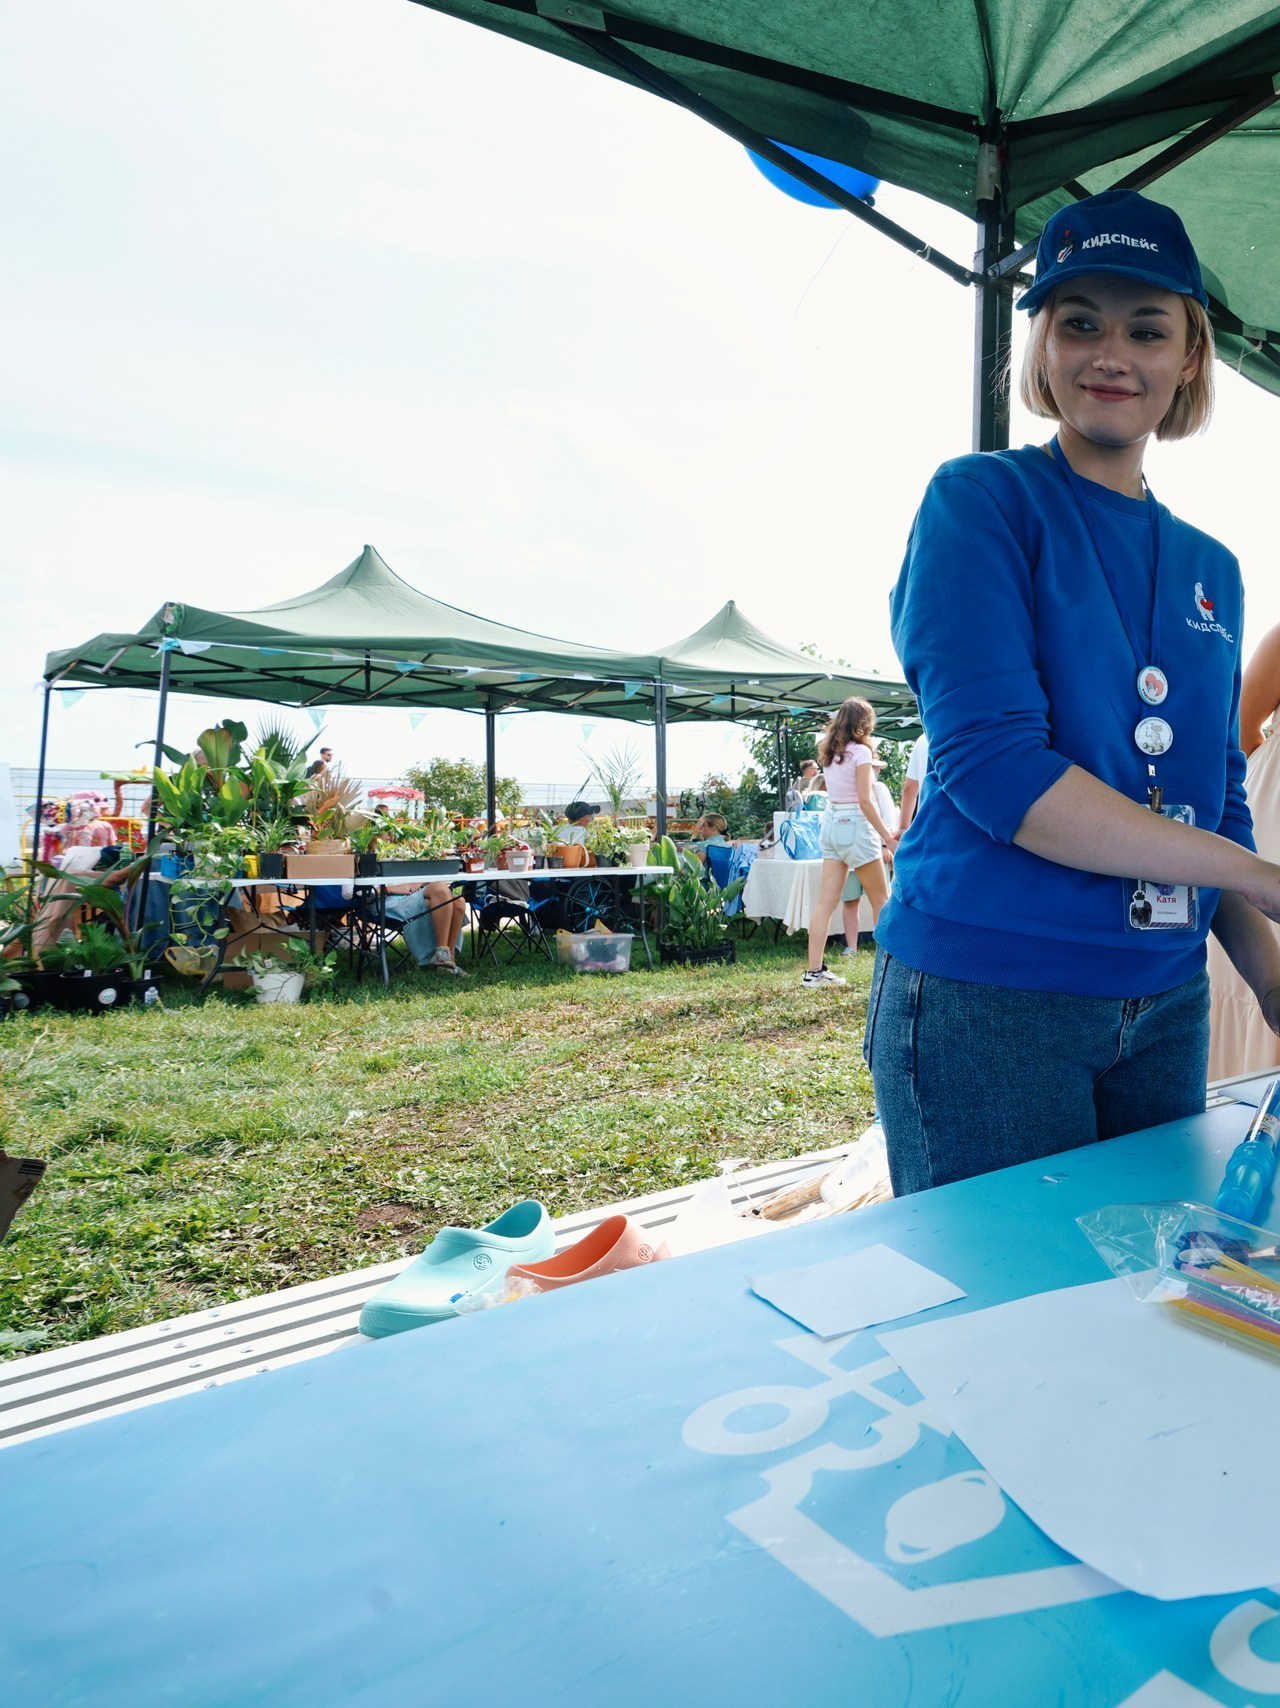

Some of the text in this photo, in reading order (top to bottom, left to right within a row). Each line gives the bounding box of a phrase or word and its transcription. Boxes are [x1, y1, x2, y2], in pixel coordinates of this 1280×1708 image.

[1081, 232, 1159, 252] КИДСПЕЙС
[1185, 617, 1234, 643] КИДСПЕЙС
[1156, 895, 1177, 904] Катя
